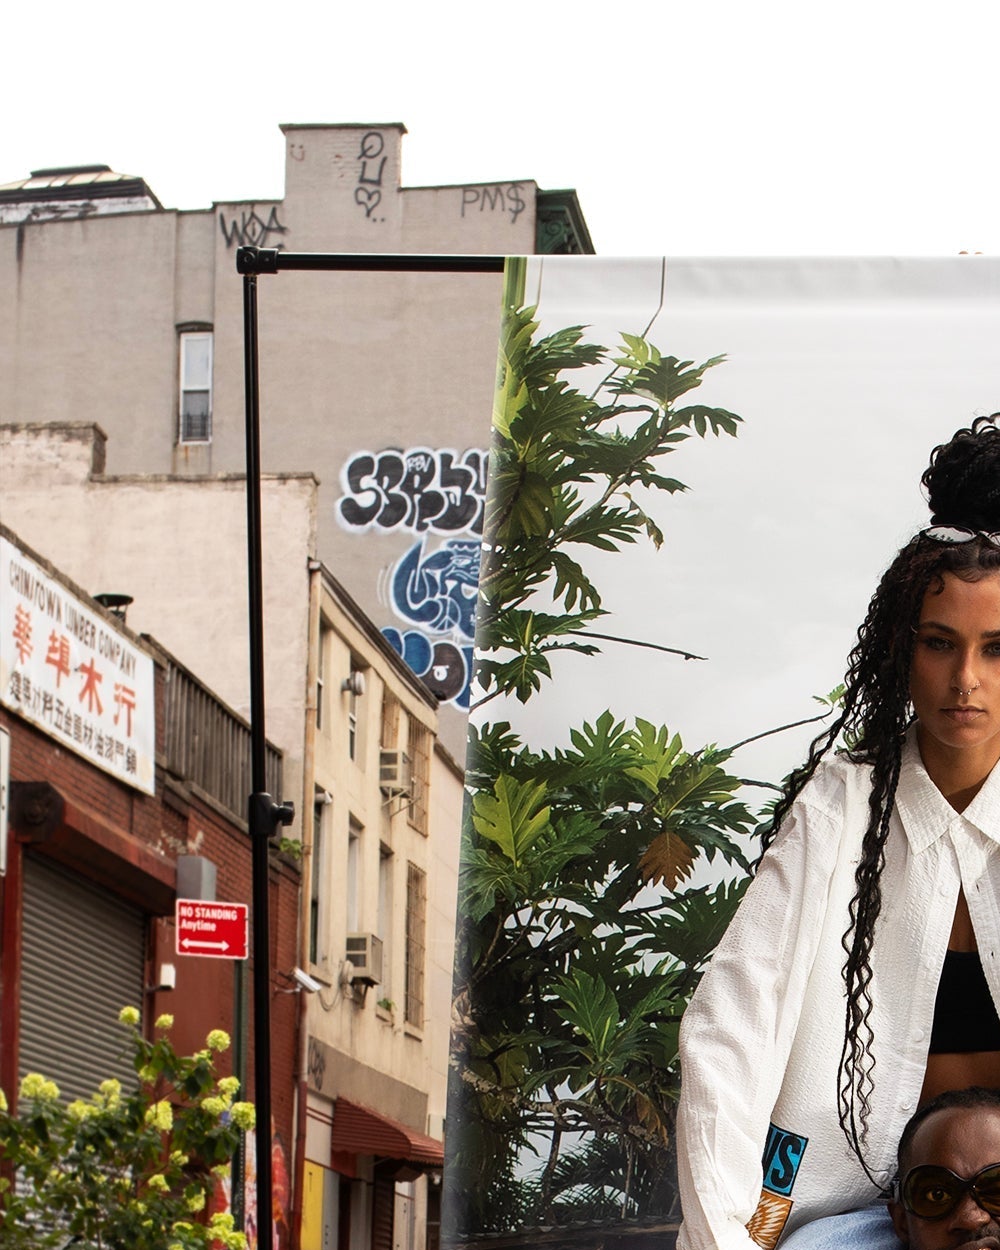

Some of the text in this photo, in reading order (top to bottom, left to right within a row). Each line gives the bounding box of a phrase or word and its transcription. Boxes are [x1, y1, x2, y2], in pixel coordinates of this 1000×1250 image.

[98, 629, 137, 681] COMPANY
[180, 906, 238, 921] NO STANDING
[181, 918, 217, 932] Anytime
